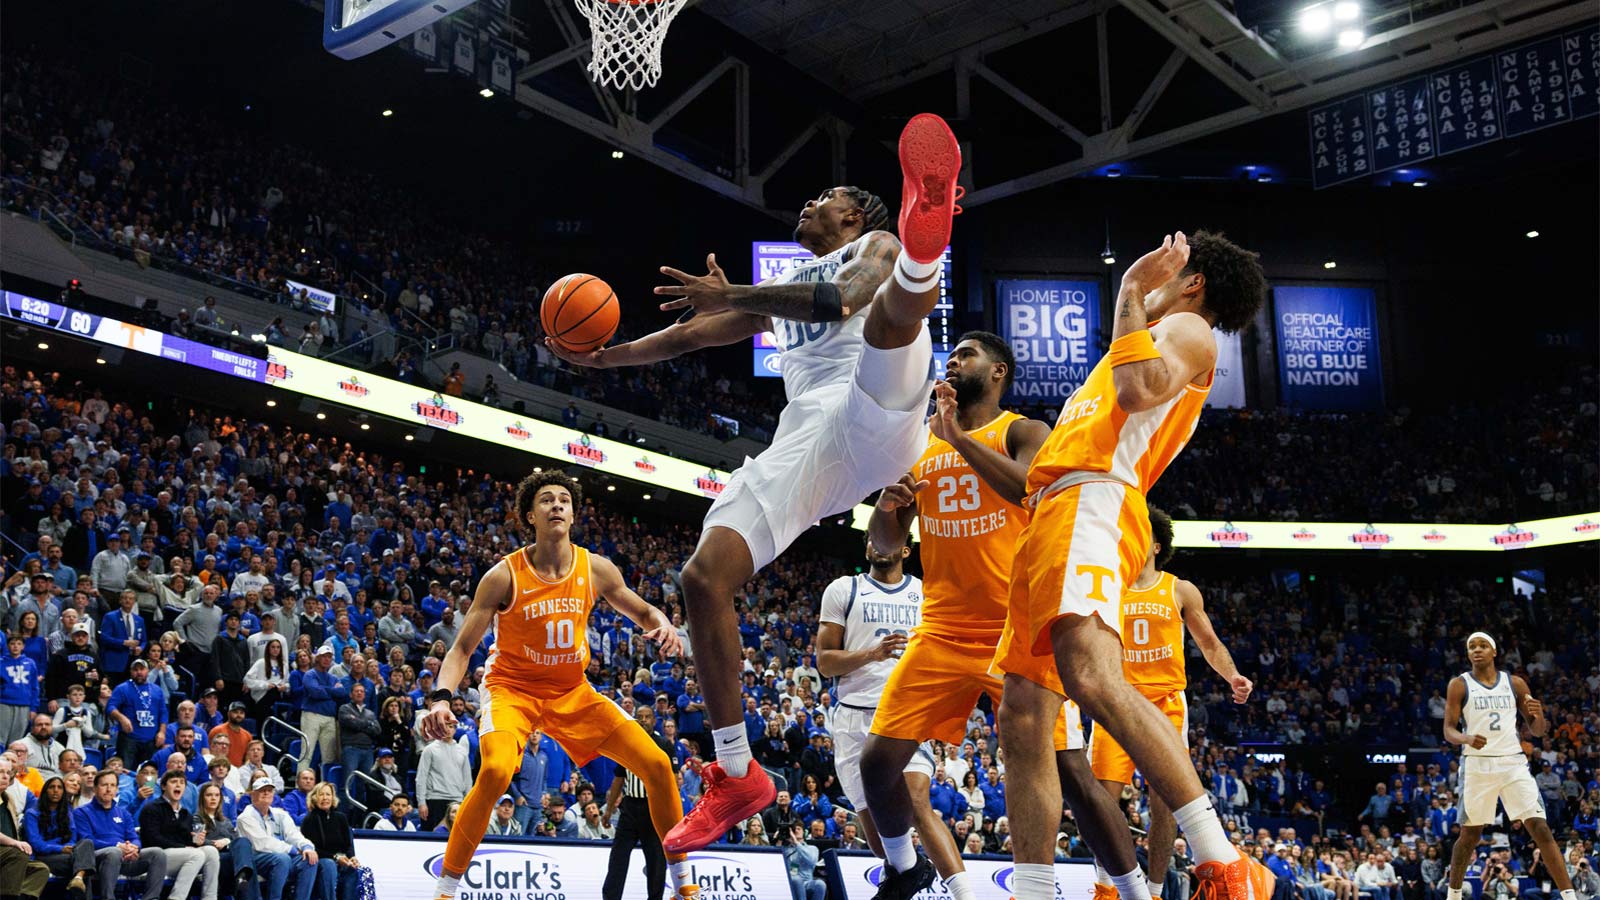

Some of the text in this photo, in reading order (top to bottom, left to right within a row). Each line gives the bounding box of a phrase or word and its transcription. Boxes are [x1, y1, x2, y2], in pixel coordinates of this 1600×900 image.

[1566, 35, 1586, 98] NCAA
[1501, 52, 1523, 114] NCAA
[1526, 50, 1545, 123] CHAMPION
[1548, 59, 1566, 120] 1951
[1435, 75, 1456, 135] NCAA
[1458, 70, 1478, 140] CHAMPION
[1479, 80, 1497, 137] 1949
[1372, 92, 1390, 150] NCAA
[1394, 89, 1411, 158] CHAMPION
[1412, 98, 1431, 155] 1948
[1313, 111, 1330, 168] NCAA
[1351, 115, 1367, 172] 1942
[21, 297, 49, 315] 6:20
[1010, 289, 1086, 304] HOME TO
[33, 314, 48, 324] HALF
[70, 312, 91, 333] 60
[1010, 304, 1087, 339] BIG
[1282, 313, 1343, 326] OFFICIAL
[120, 321, 145, 349] T
[1284, 326, 1371, 340] HEALTHCARE
[212, 350, 238, 365] TIMEOUTS
[1011, 339, 1088, 363] BLUE
[1285, 340, 1366, 353] PARTNER OF
[1286, 354, 1367, 369] BIG BLUE
[1287, 371, 1359, 386] NATION
[418, 401, 458, 424] TEXAS
[568, 443, 603, 463] TEXAS
[937, 474, 981, 513] 23
[921, 509, 1007, 538] VOLUNTEERS
[1212, 532, 1248, 542] TEXAS
[1353, 533, 1389, 543] TEXAS
[1076, 564, 1115, 603] T
[863, 602, 918, 626] KENTUCKY
[545, 619, 574, 649] 10
[1133, 619, 1149, 645] 0
[5, 665, 30, 684] UK
[1474, 695, 1511, 710] KENTUCKY
[136, 710, 155, 727] UK
[1489, 712, 1501, 731] 2
[1367, 754, 1406, 763] .COM
[464, 859, 562, 890] Clark's
